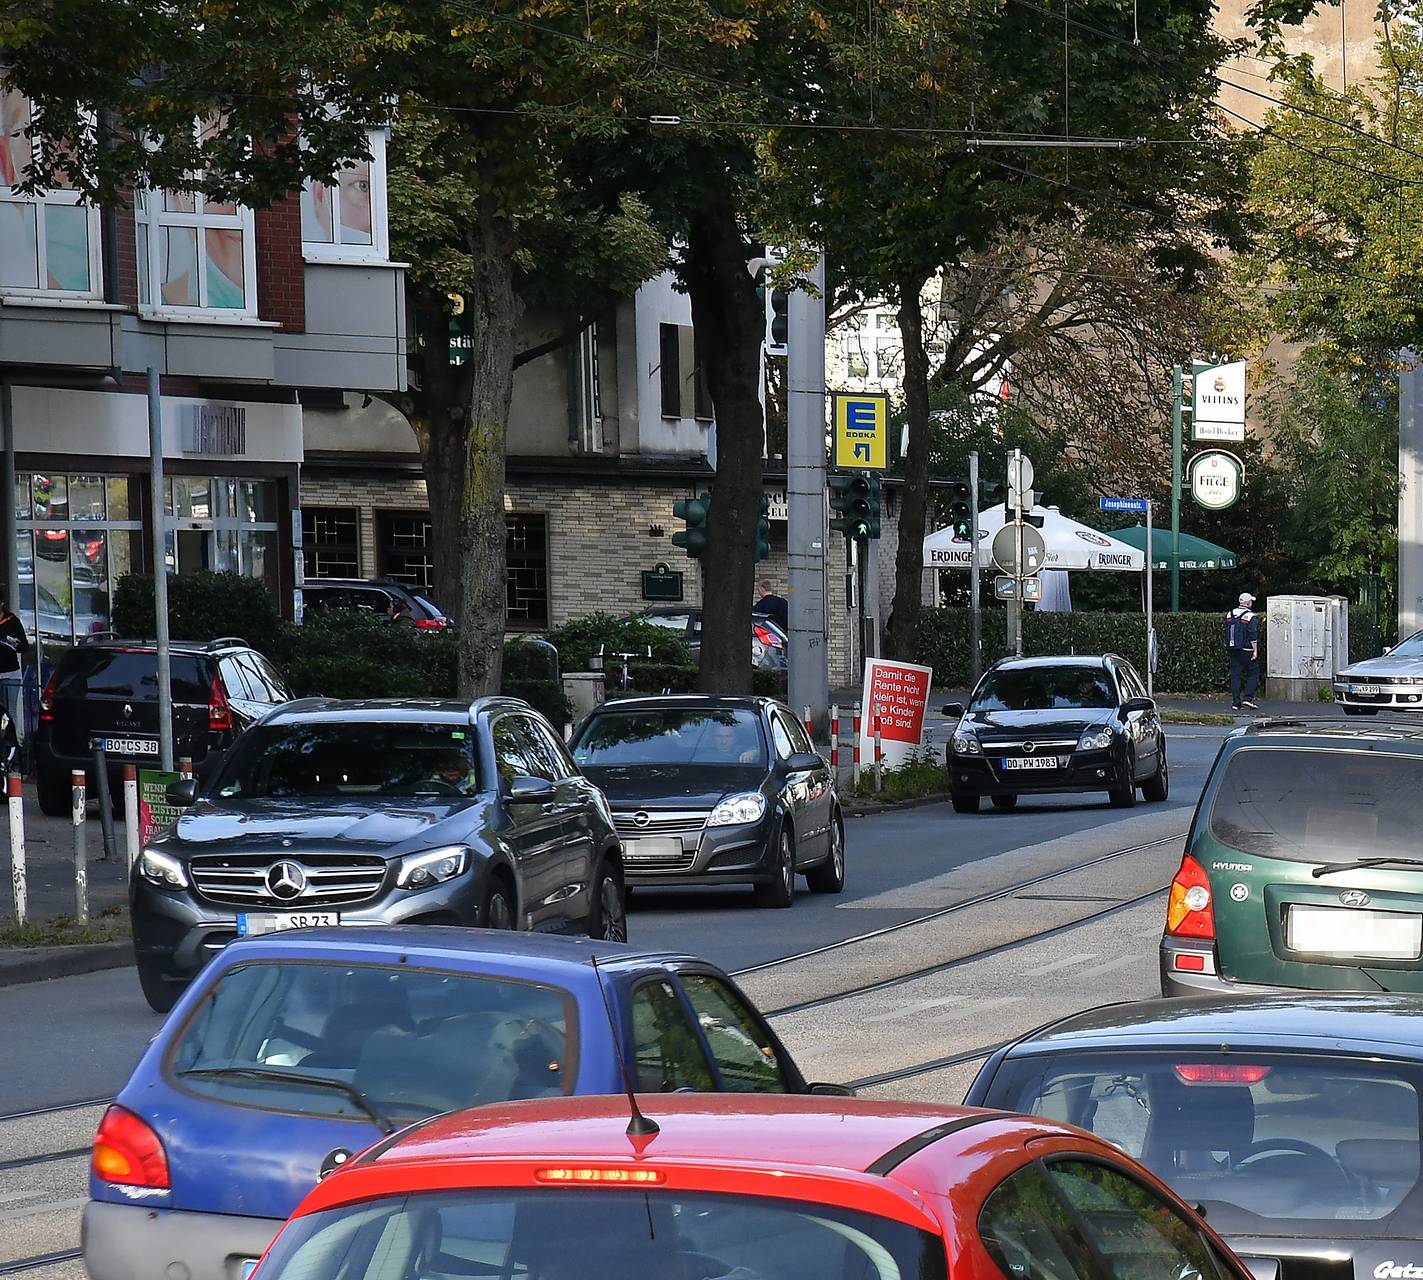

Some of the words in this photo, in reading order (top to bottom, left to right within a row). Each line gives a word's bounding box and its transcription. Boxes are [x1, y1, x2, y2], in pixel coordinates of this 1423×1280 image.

[1104, 499, 1143, 510] Josephinenstr.
[931, 550, 974, 563] ERDINGE
[1098, 553, 1132, 566] ERDINGER
[875, 668, 903, 681] Damit
[904, 674, 916, 682] die
[874, 680, 901, 691] Rente
[903, 685, 920, 694] nicht
[873, 691, 894, 702] klein
[896, 694, 908, 705] ist,
[889, 705, 915, 717] Kinder
[895, 719, 913, 729] sind.
[106, 740, 121, 750] BO
[126, 741, 141, 752] CS
[143, 741, 157, 752] 38
[1035, 758, 1056, 768] 1983
[1212, 861, 1253, 871] HYUNDAI
